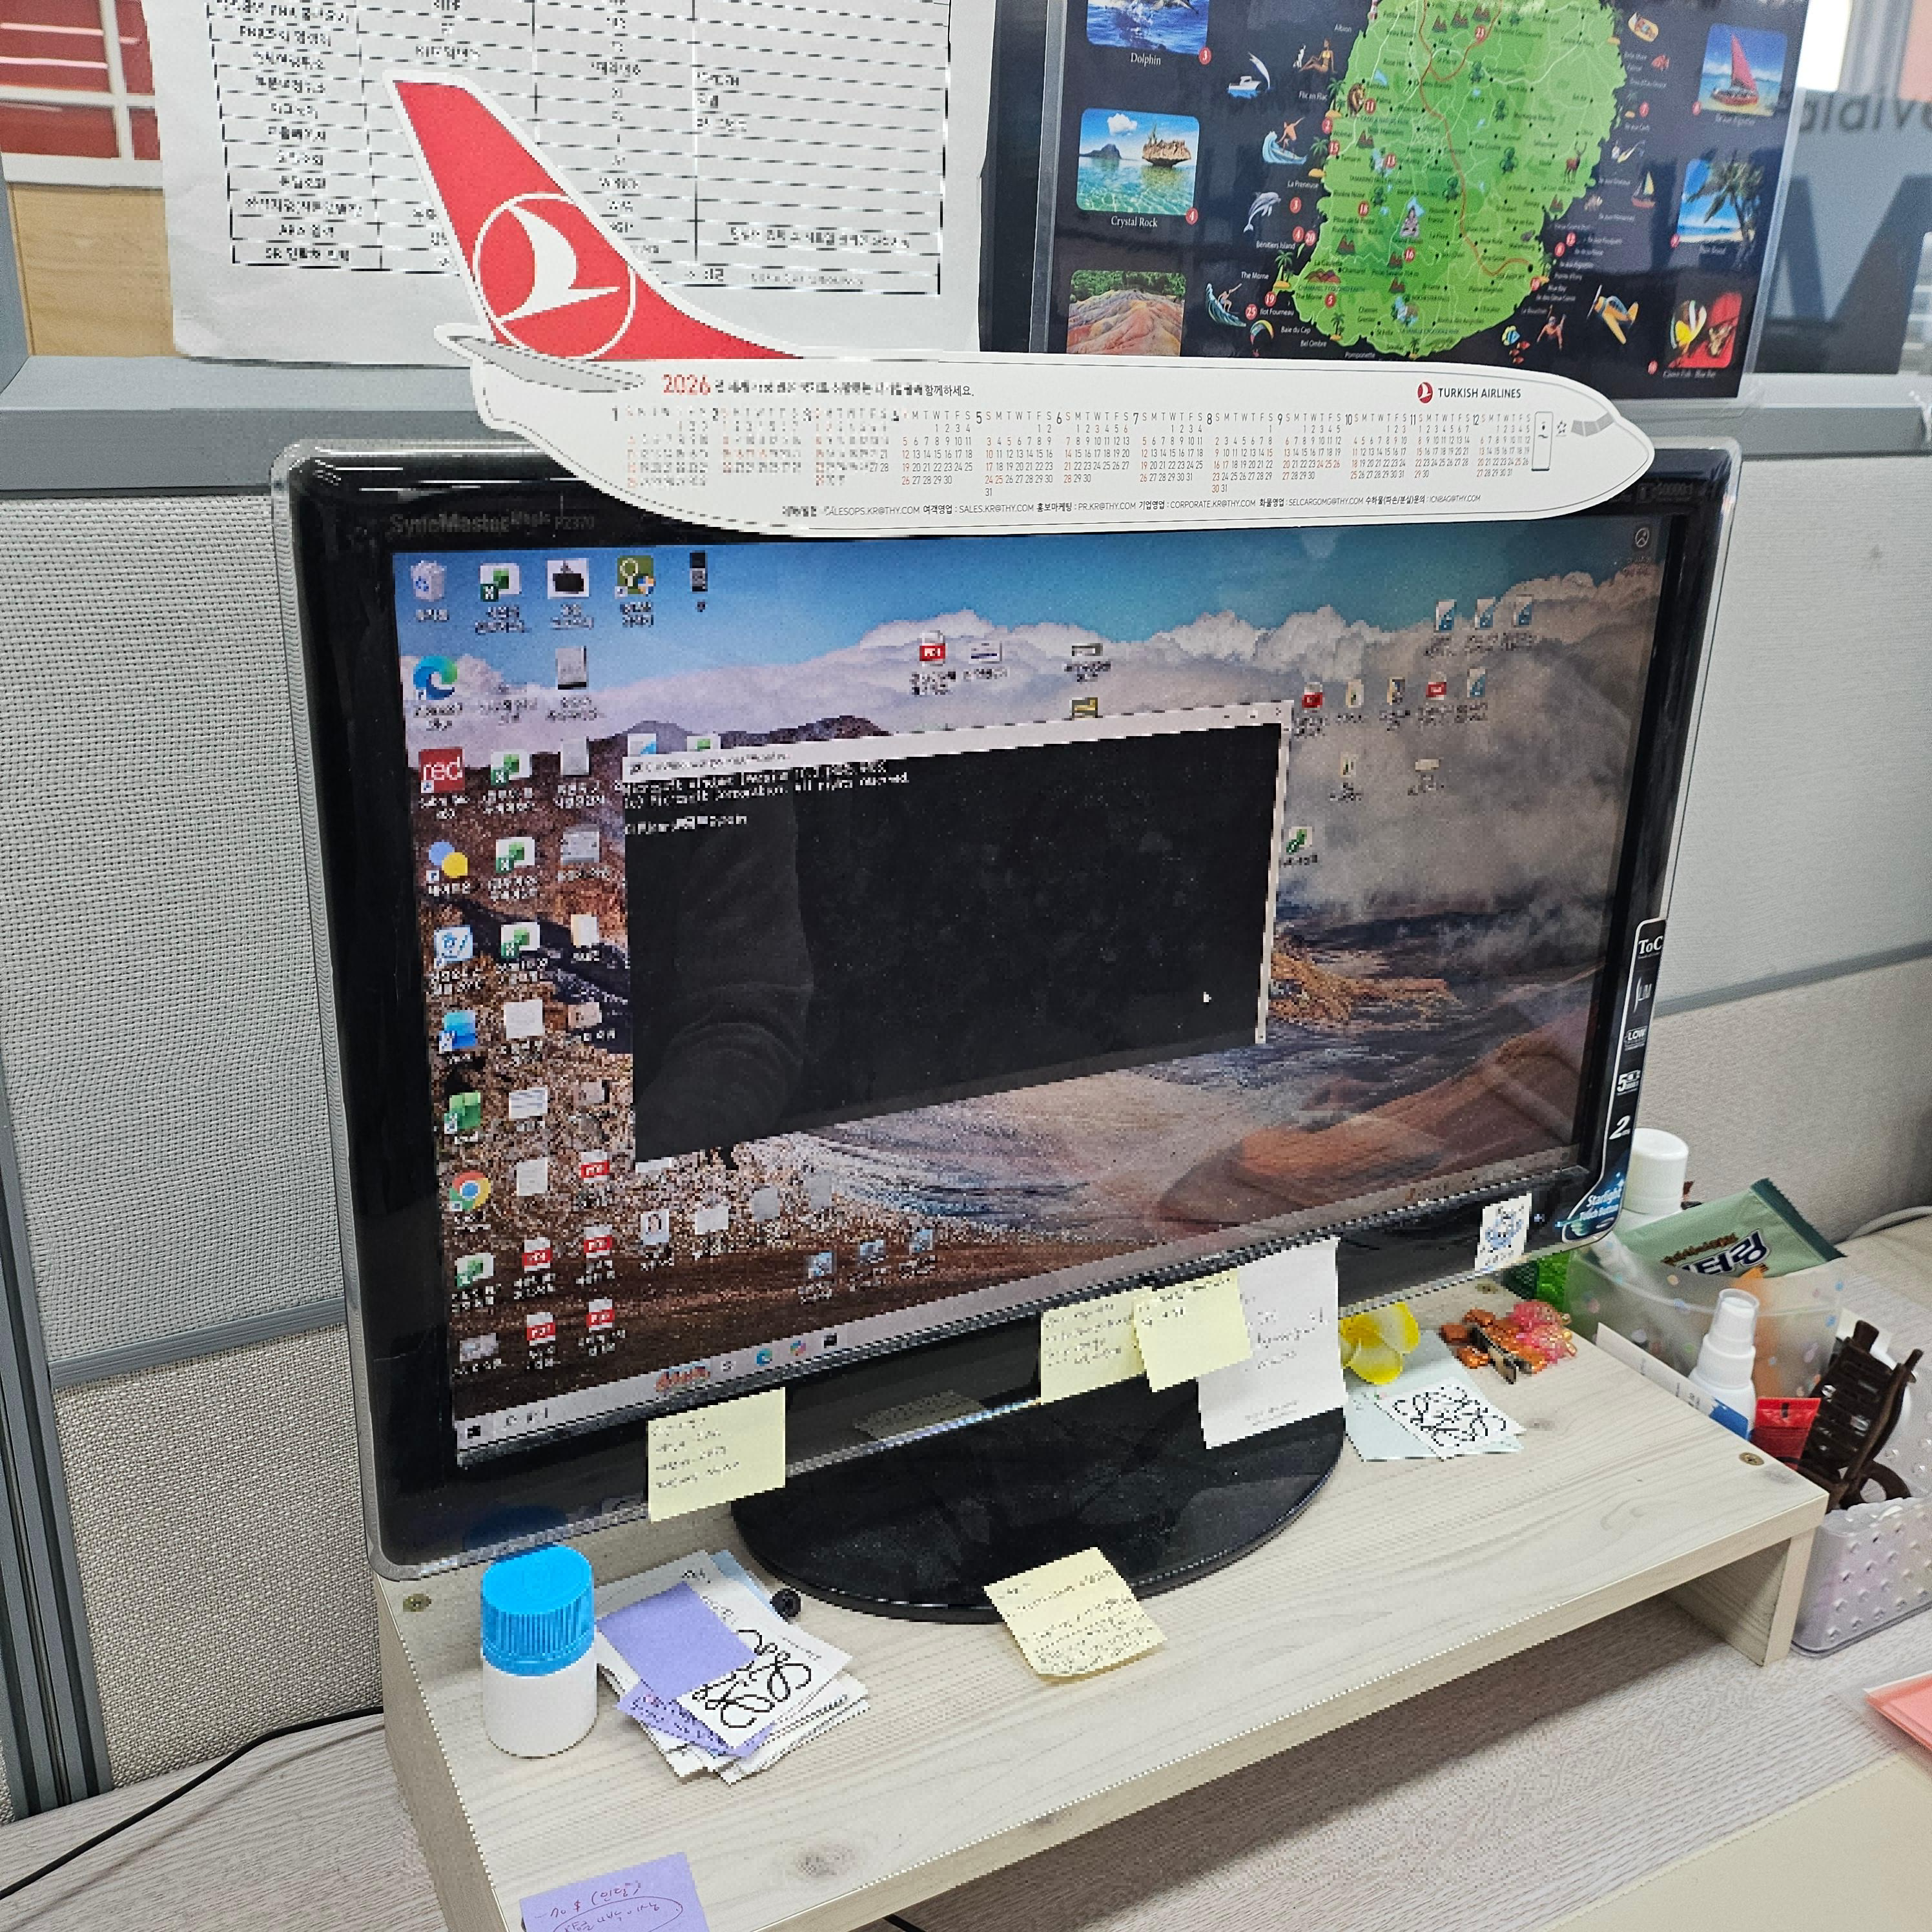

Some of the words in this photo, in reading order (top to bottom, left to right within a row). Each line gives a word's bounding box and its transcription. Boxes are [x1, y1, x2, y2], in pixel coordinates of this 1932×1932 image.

[1334, 25, 1352, 33] Albion
[1130, 52, 1162, 67] Dolphin
[1111, 216, 1137, 227] Crystal
[1139, 217, 1158, 227] Rock
[1280, 241, 1295, 249] Island
[1300, 327, 1311, 336] Cap
[662, 374, 710, 396] 2026
[925, 384, 974, 397] 함께하세요.
[1438, 387, 1478, 399] TURKISH
[1481, 389, 1521, 398] AIRLINES
[977, 411, 983, 424] 5
[987, 411, 991, 420] S
[997, 411, 1002, 420] M
[1008, 411, 1012, 420] T
[1028, 411, 1032, 420] T
[1038, 411, 1042, 420] F
[1047, 411, 1052, 420] S
[1057, 412, 1063, 424] 6
[1067, 412, 1071, 420] S
[1076, 412, 1082, 420] M
[1086, 412, 1091, 420] T
[1094, 412, 1101, 420] W
[1105, 412, 1109, 420] T
[1115, 412, 1119, 420] F
[1125, 412, 1129, 421] S
[1134, 413, 1139, 425] 7
[1208, 413, 1213, 425] 8
[1279, 413, 1283, 426] 9
[1345, 413, 1353, 425] 10
[1410, 414, 1416, 425] 11
[1473, 414, 1479, 426] 12
[1039, 424, 1041, 433] 1
[1048, 424, 1052, 433] 2
[988, 437, 992, 446] 3
[1008, 437, 1012, 446] 5
[1018, 437, 1022, 446] 6
[1028, 437, 1032, 446] 7
[1038, 437, 1042, 445] 8
[1048, 437, 1052, 446] 9
[1067, 437, 1071, 446] 7
[1077, 437, 1081, 445] 8
[1087, 437, 1090, 446] 9
[1095, 437, 1102, 446] 10
[1105, 437, 1110, 446] 11
[1115, 437, 1121, 446] 12
[1124, 437, 1130, 445] 13
[903, 450, 910, 458] 12
[914, 449, 921, 458] 13
[924, 450, 931, 458] 14
[935, 449, 942, 458] 15
[945, 449, 952, 458] 16
[956, 449, 962, 458] 17
[967, 449, 973, 458] 18
[987, 450, 994, 458] 10
[997, 449, 1003, 458] 11
[1007, 449, 1014, 458] 12
[1017, 449, 1024, 458] 13
[1027, 449, 1034, 458] 14
[1037, 449, 1043, 458] 15
[1047, 449, 1053, 458] 16
[1066, 449, 1072, 458] 14
[1076, 449, 1082, 458] 15
[1085, 449, 1092, 458] 16
[1104, 449, 1111, 457] 18
[1115, 449, 1121, 458] 19
[1122, 449, 1130, 457] 20
[1037, 502, 1073, 512] 홍보마케팅
[1078, 502, 1136, 510] PR.KR@THY.COM
[1138, 501, 1165, 510] 기업영업
[1170, 500, 1256, 509] CORPORATE.KR@THY.COM
[1259, 498, 1285, 508] 화물영업
[923, 505, 952, 515] 여객영업
[959, 505, 1034, 513] SALES.KR@THY.COM
[420, 756, 463, 781] red
[1638, 936, 1663, 954] ToC
[1627, 1028, 1646, 1041] LOW
[1585, 1187, 1622, 1208] Starlight
[1681, 1228, 1769, 1275] 터링
